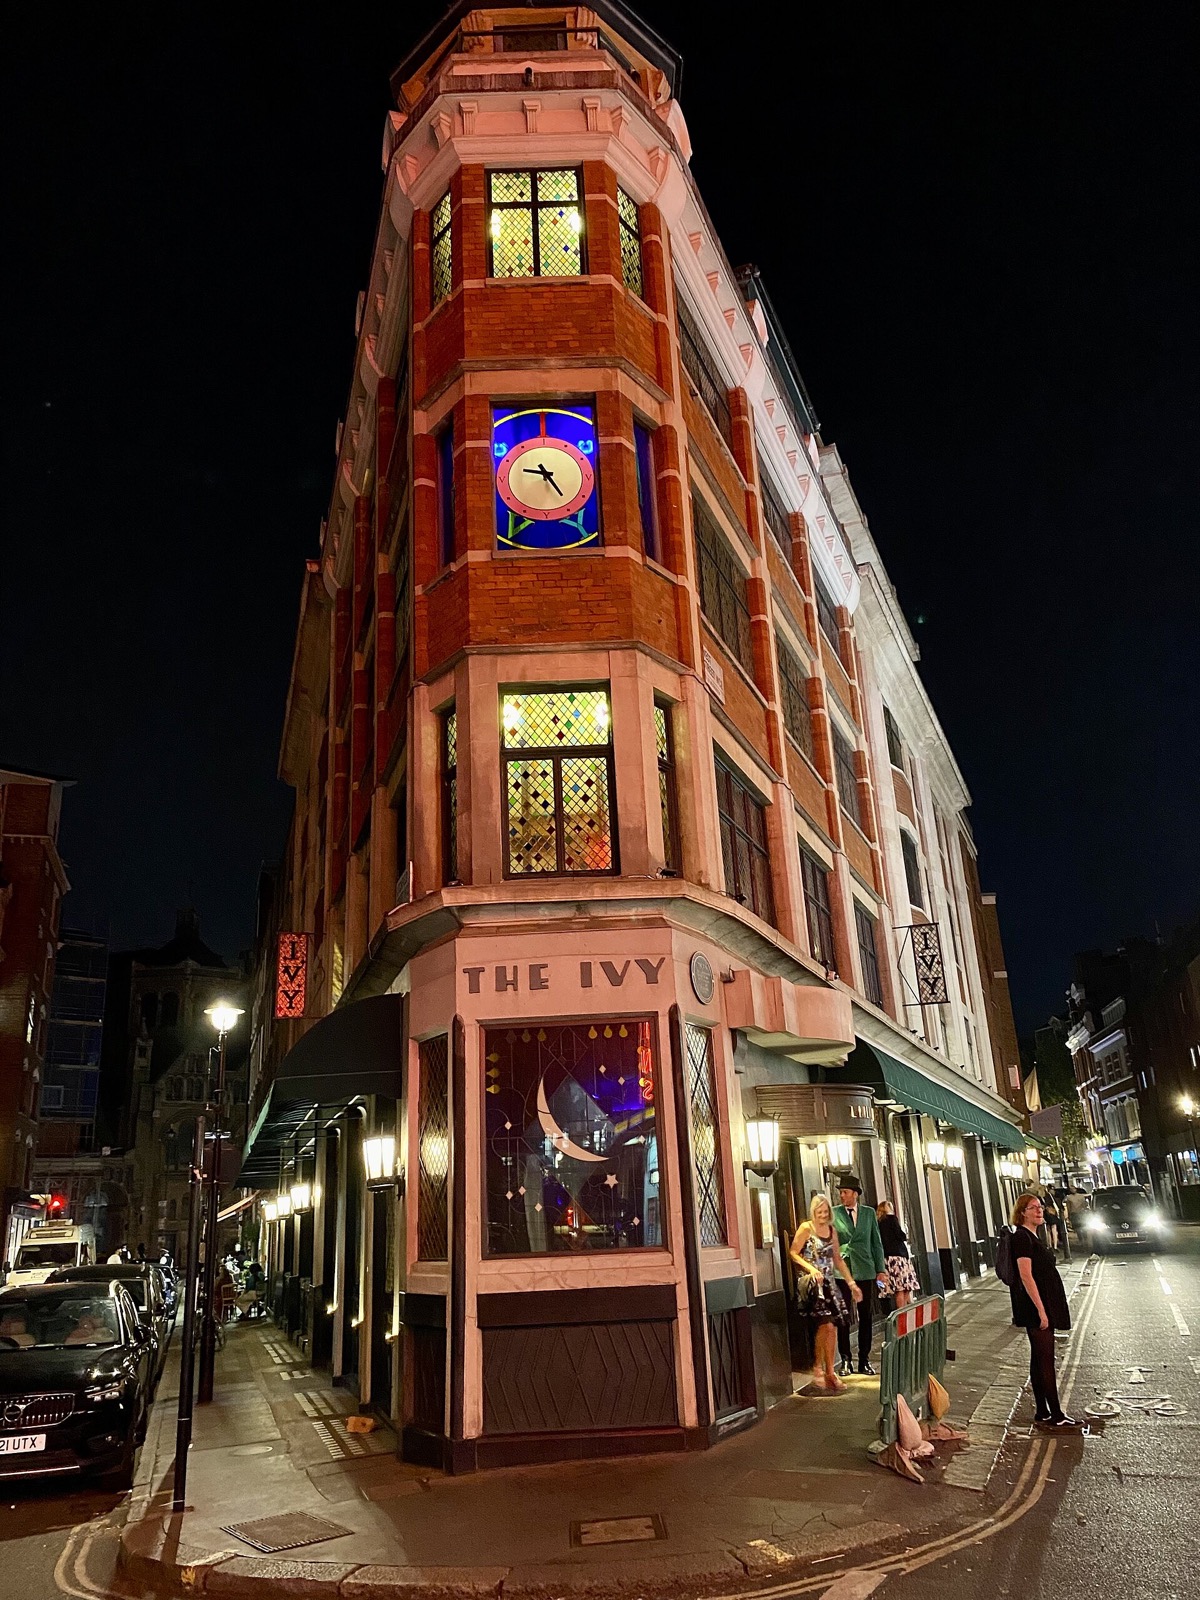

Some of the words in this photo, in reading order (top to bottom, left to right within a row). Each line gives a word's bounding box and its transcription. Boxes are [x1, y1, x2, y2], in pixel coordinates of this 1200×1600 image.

[280, 940, 303, 1009] IVY
[463, 963, 549, 994] THE
[580, 957, 666, 988] IVY
[918, 932, 942, 996] IVY
[12, 1436, 38, 1450] UTX
